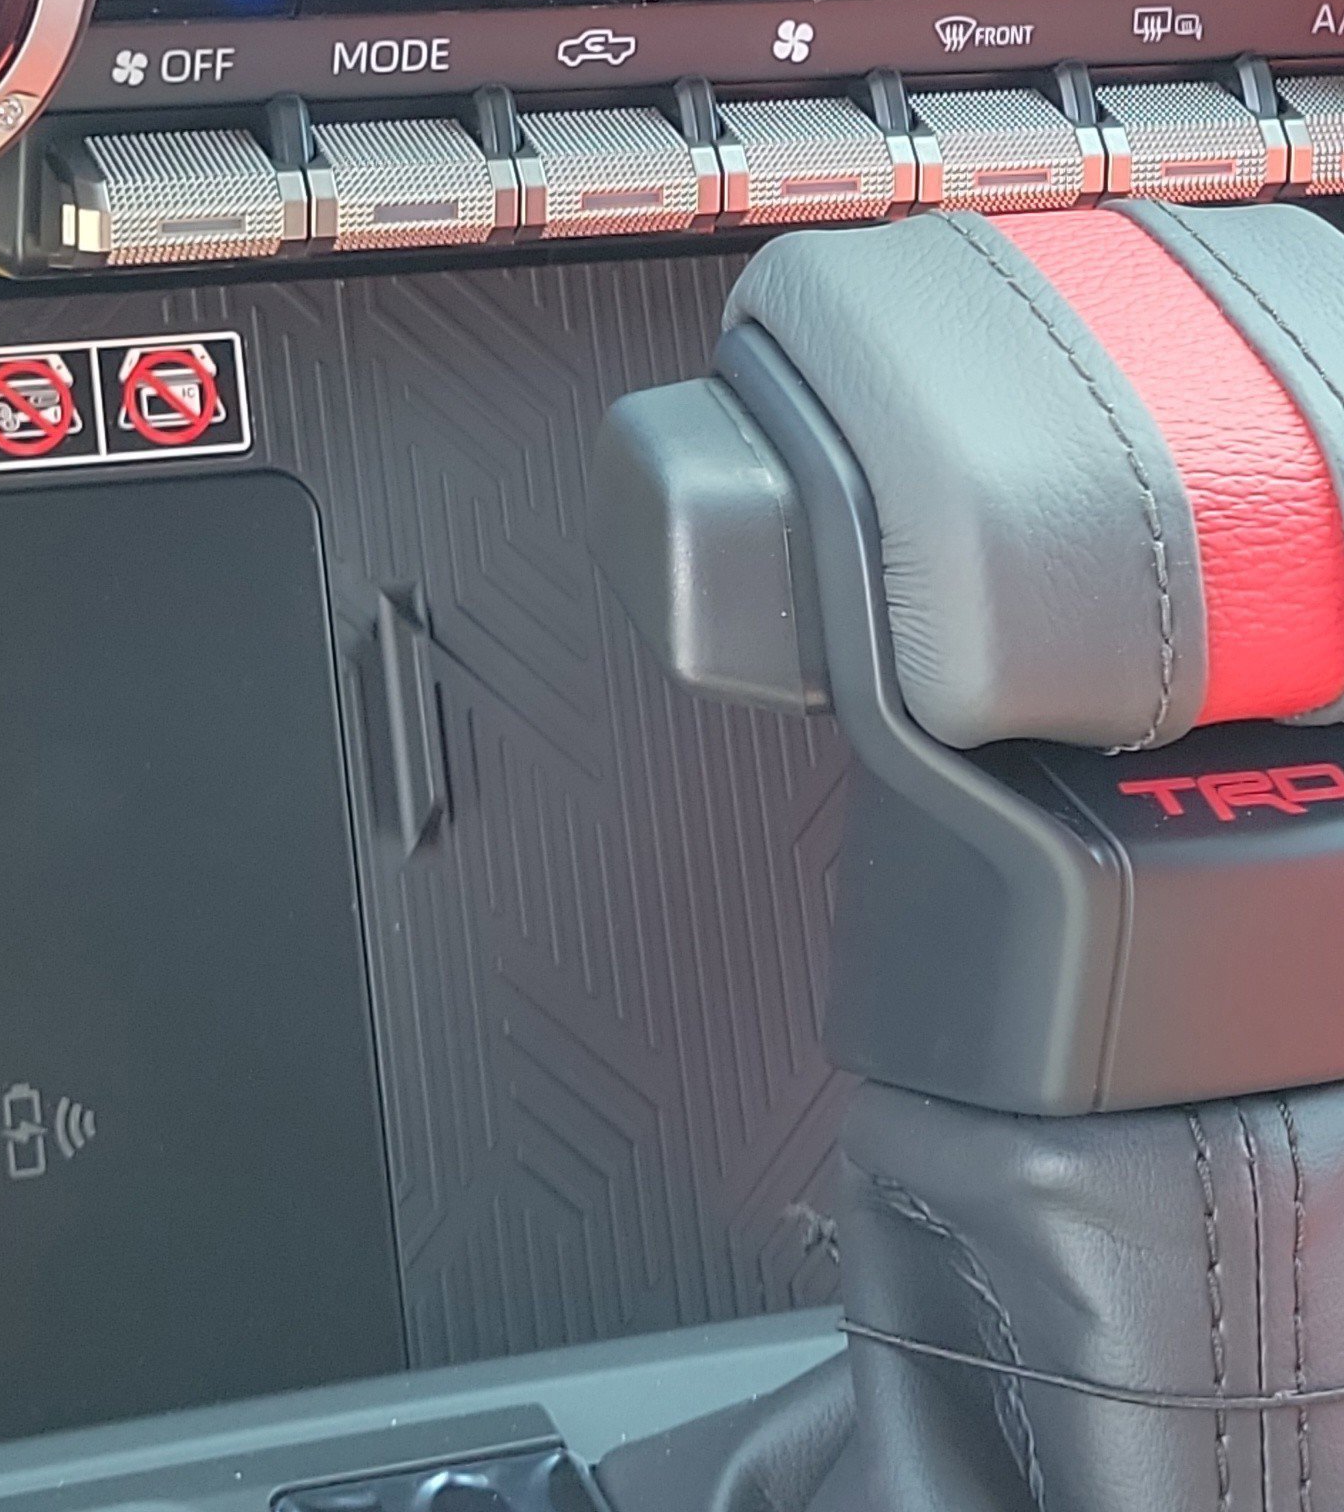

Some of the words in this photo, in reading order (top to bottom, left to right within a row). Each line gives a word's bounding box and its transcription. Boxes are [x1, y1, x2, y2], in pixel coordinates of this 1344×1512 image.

[973, 22, 1035, 48] FRONT
[159, 46, 236, 84] OFF
[331, 36, 452, 76] MODE
